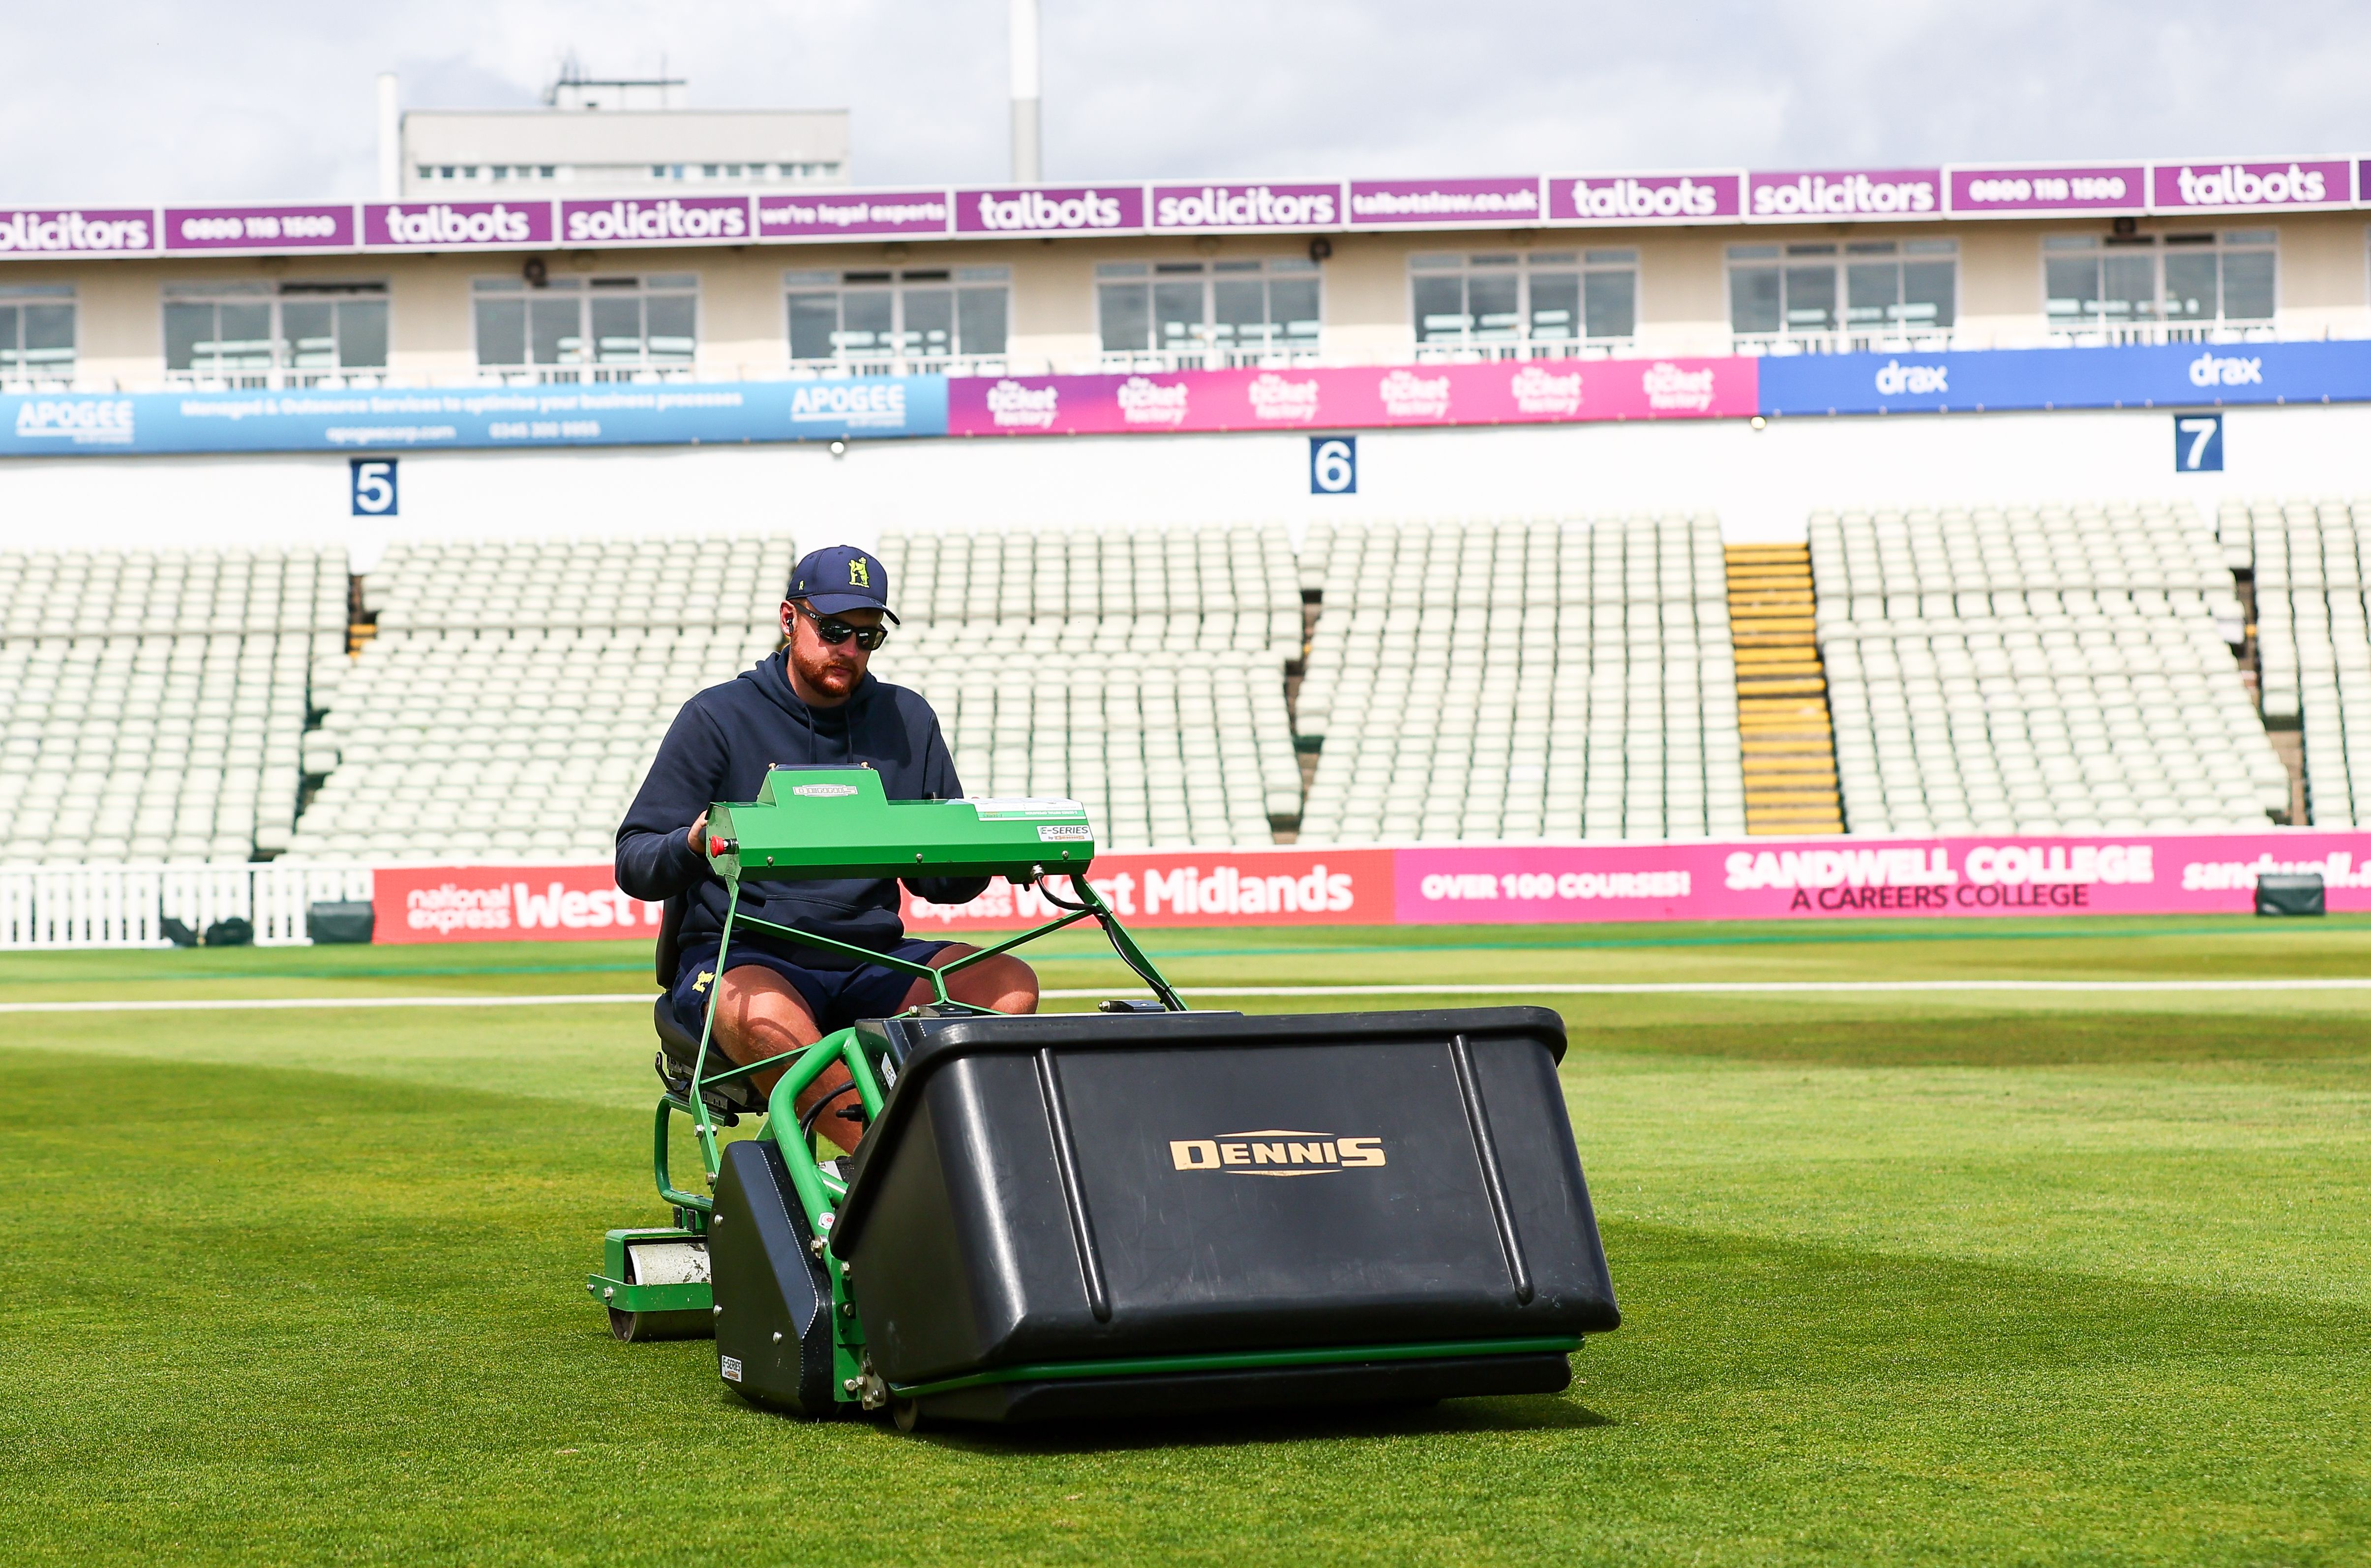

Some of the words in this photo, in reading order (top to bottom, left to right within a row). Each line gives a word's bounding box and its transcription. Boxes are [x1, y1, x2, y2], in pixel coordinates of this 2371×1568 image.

[1572, 179, 1717, 217] talbots
[1754, 174, 1935, 213] solicitors
[2177, 164, 2327, 205] talbots
[386, 205, 531, 242] talbots
[569, 200, 745, 240] solicitors
[817, 202, 869, 227] legal
[870, 202, 945, 225] experts
[979, 191, 1121, 229] talbots
[1158, 187, 1335, 226] solicitors
[1875, 360, 1949, 395] drax
[2189, 352, 2262, 387] drax
[16, 400, 134, 427] APOGEE
[791, 385, 905, 412] APOGEE
[2180, 419, 2217, 469] 7
[1315, 441, 1352, 491] 6
[356, 463, 393, 513] 5
[1421, 874, 1498, 900] OVER
[1501, 873, 1555, 899] 100
[1557, 870, 1691, 898] COURSES!
[1725, 849, 1958, 889] SANDWELL
[1965, 845, 2155, 884] COLLEGE
[407, 883, 510, 910] national
[512, 882, 636, 929] West
[1143, 864, 1354, 915] Midlands
[1790, 887, 1811, 910] A
[1819, 885, 1948, 909] CAREERS
[1956, 884, 2089, 907] COLLEGE
[407, 907, 511, 935] express
[1169, 1137, 1387, 1171] DENNIS
[723, 1357, 741, 1372] E-SERIES
